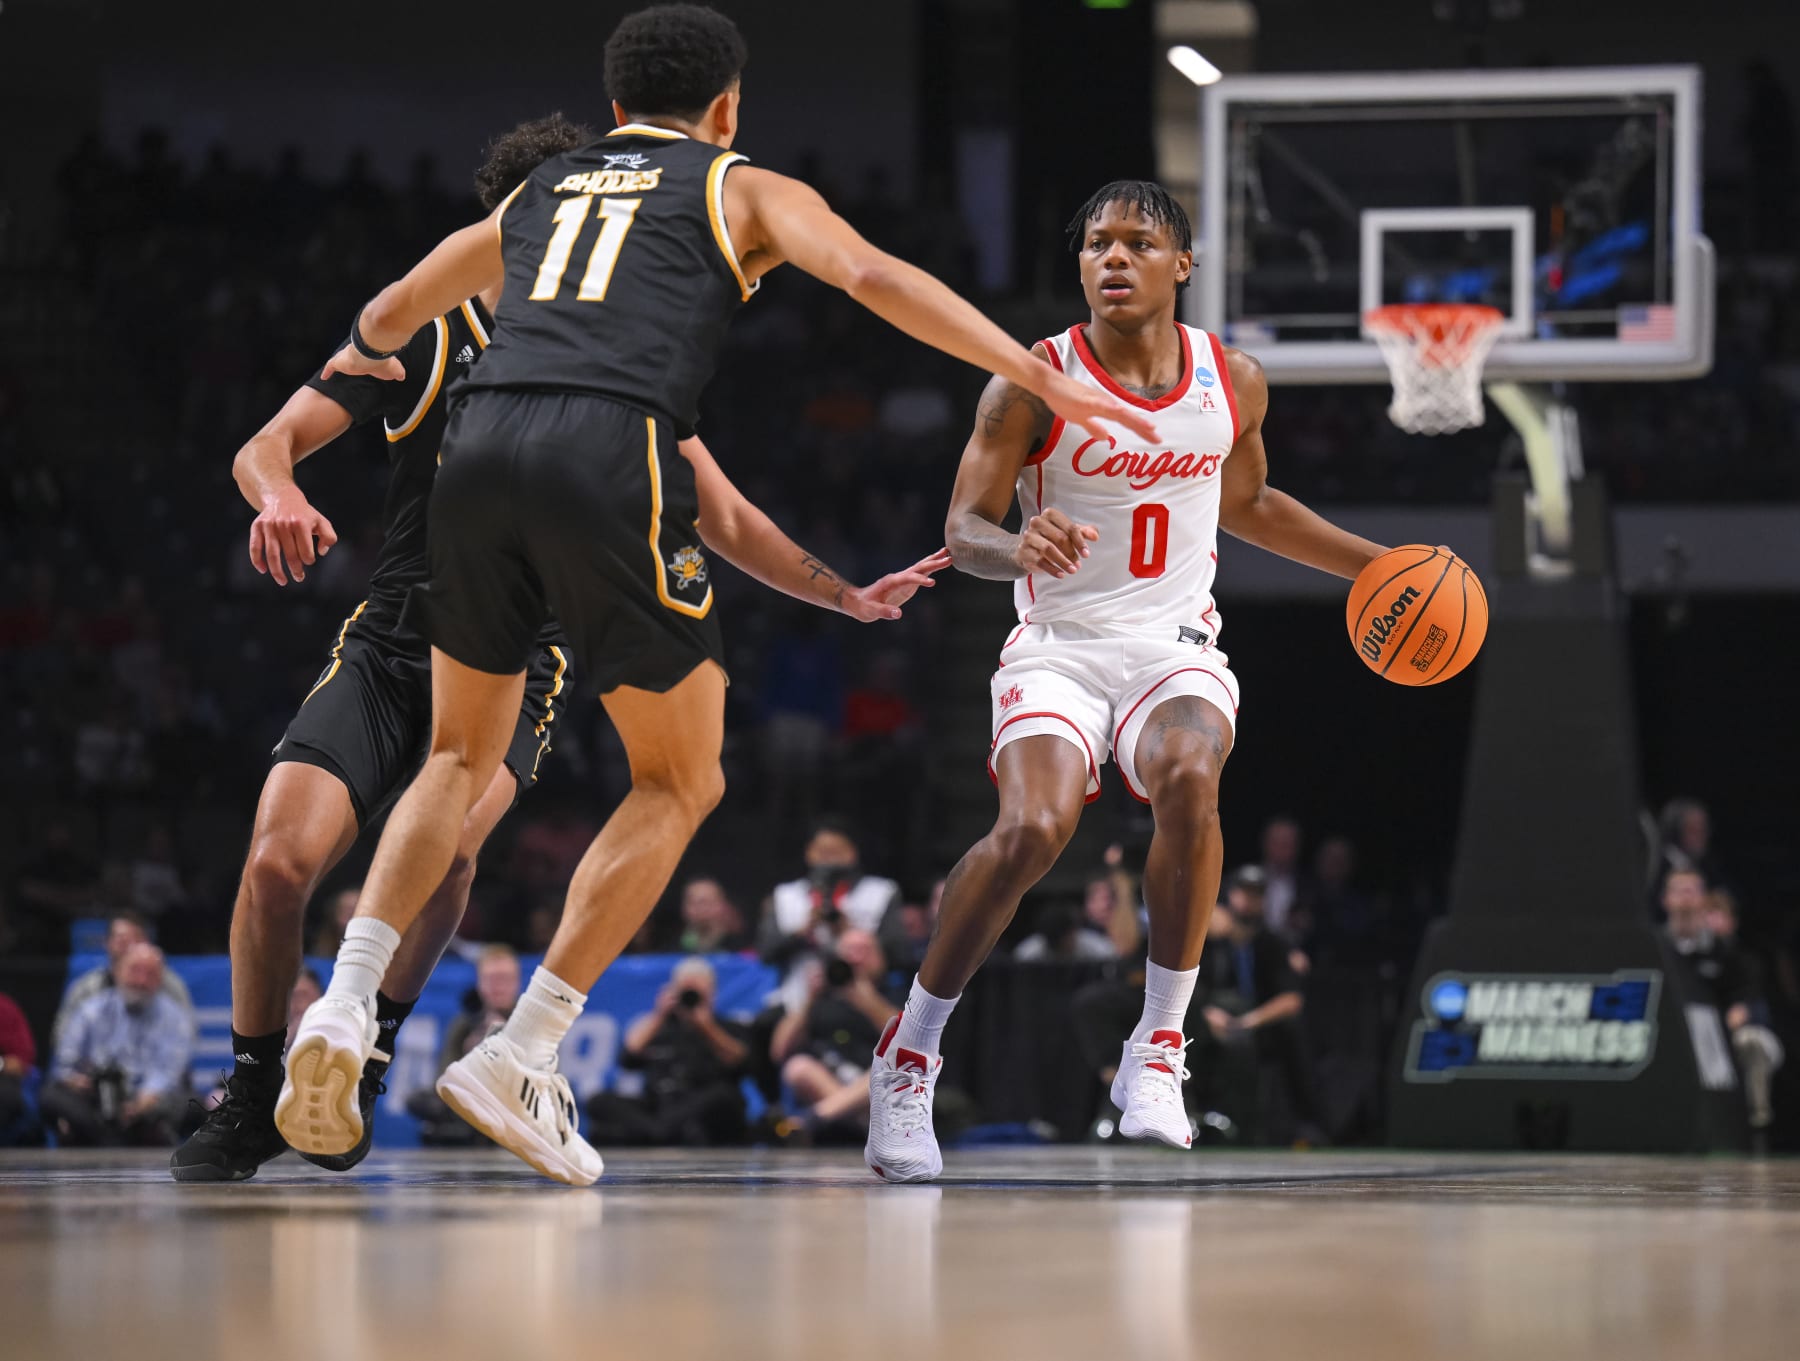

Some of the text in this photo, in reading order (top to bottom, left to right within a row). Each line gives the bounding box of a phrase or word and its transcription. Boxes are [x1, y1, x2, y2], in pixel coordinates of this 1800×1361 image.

[554, 168, 663, 194] RHODES
[528, 194, 642, 301] 11
[1072, 435, 1221, 490] Cougars
[1129, 504, 1169, 578] 0
[1361, 585, 1422, 663] Wilson
[1414, 637, 1433, 661] MARCH
[1423, 629, 1446, 662] MADNESS
[1466, 981, 1592, 1022] MARCH
[1477, 1020, 1648, 1062] MADNESS
